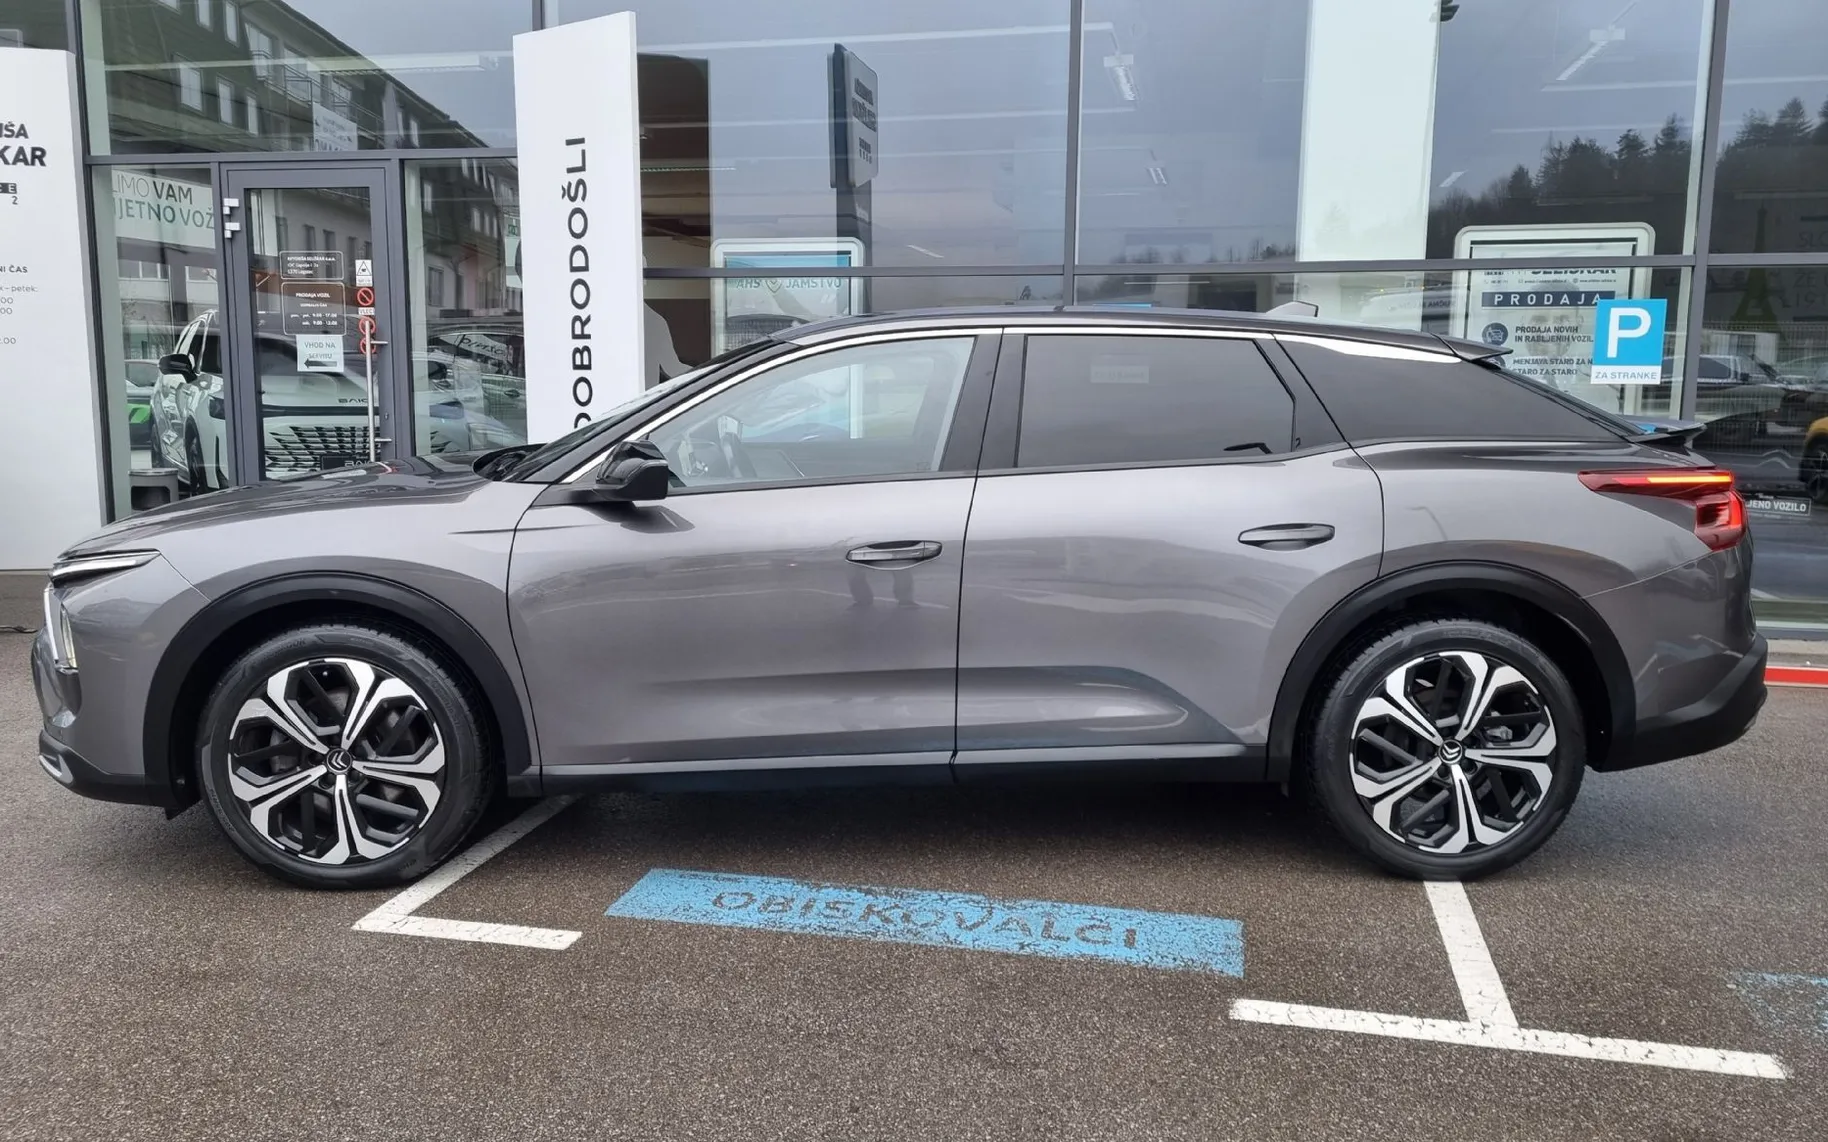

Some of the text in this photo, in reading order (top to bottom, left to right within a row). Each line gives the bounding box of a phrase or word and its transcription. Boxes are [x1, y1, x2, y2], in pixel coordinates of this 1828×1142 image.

[153, 180, 193, 205] VAM
[8, 264, 29, 273] ČAS
[1515, 326, 1579, 334] PRODAJA NOVIH
[1607, 307, 1651, 358] P
[304, 341, 324, 349] VHOD
[1539, 368, 1550, 376] ZA
[1551, 368, 1578, 376] STARO
[1595, 371, 1658, 379] ZA STRANKE
[1773, 502, 1807, 512] VOZILO
